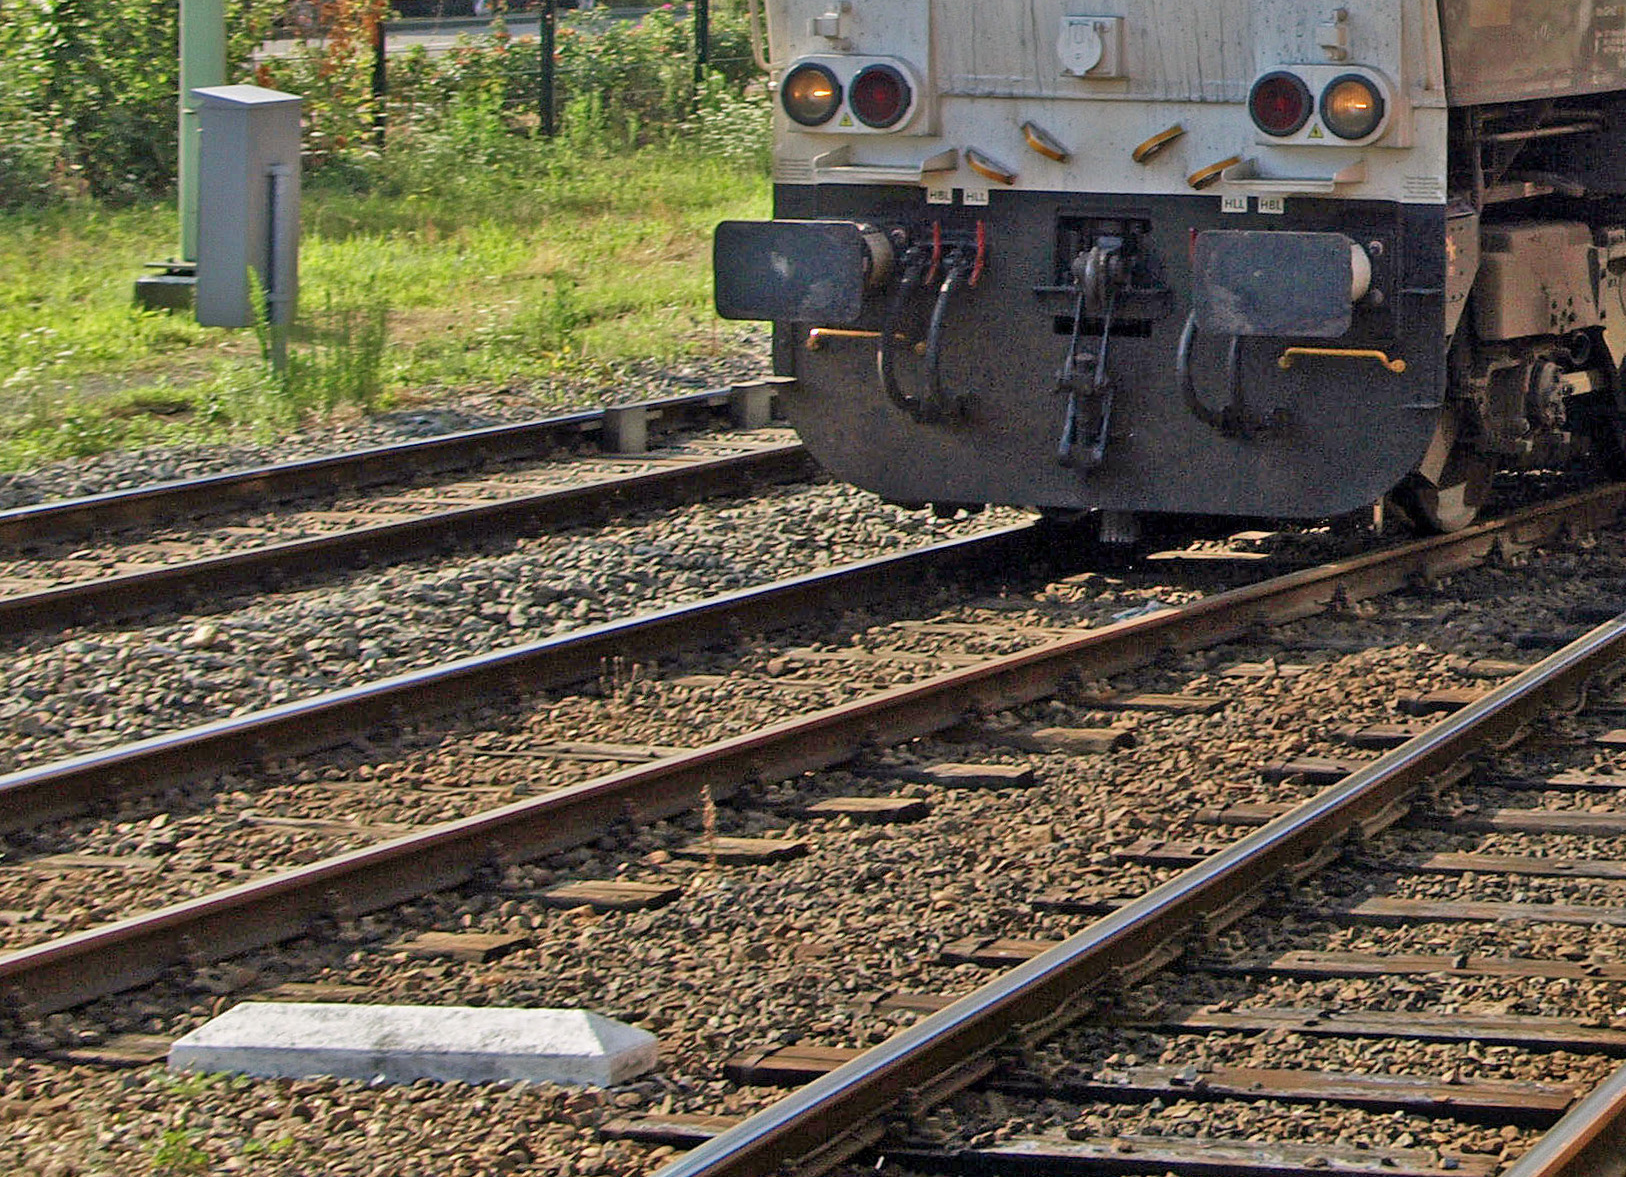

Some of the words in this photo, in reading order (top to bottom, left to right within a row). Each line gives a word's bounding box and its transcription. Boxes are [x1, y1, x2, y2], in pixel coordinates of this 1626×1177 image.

[929, 190, 951, 201] HBL
[966, 192, 986, 202] HLL
[1224, 198, 1244, 209] HLL
[1260, 199, 1282, 210] HBL
